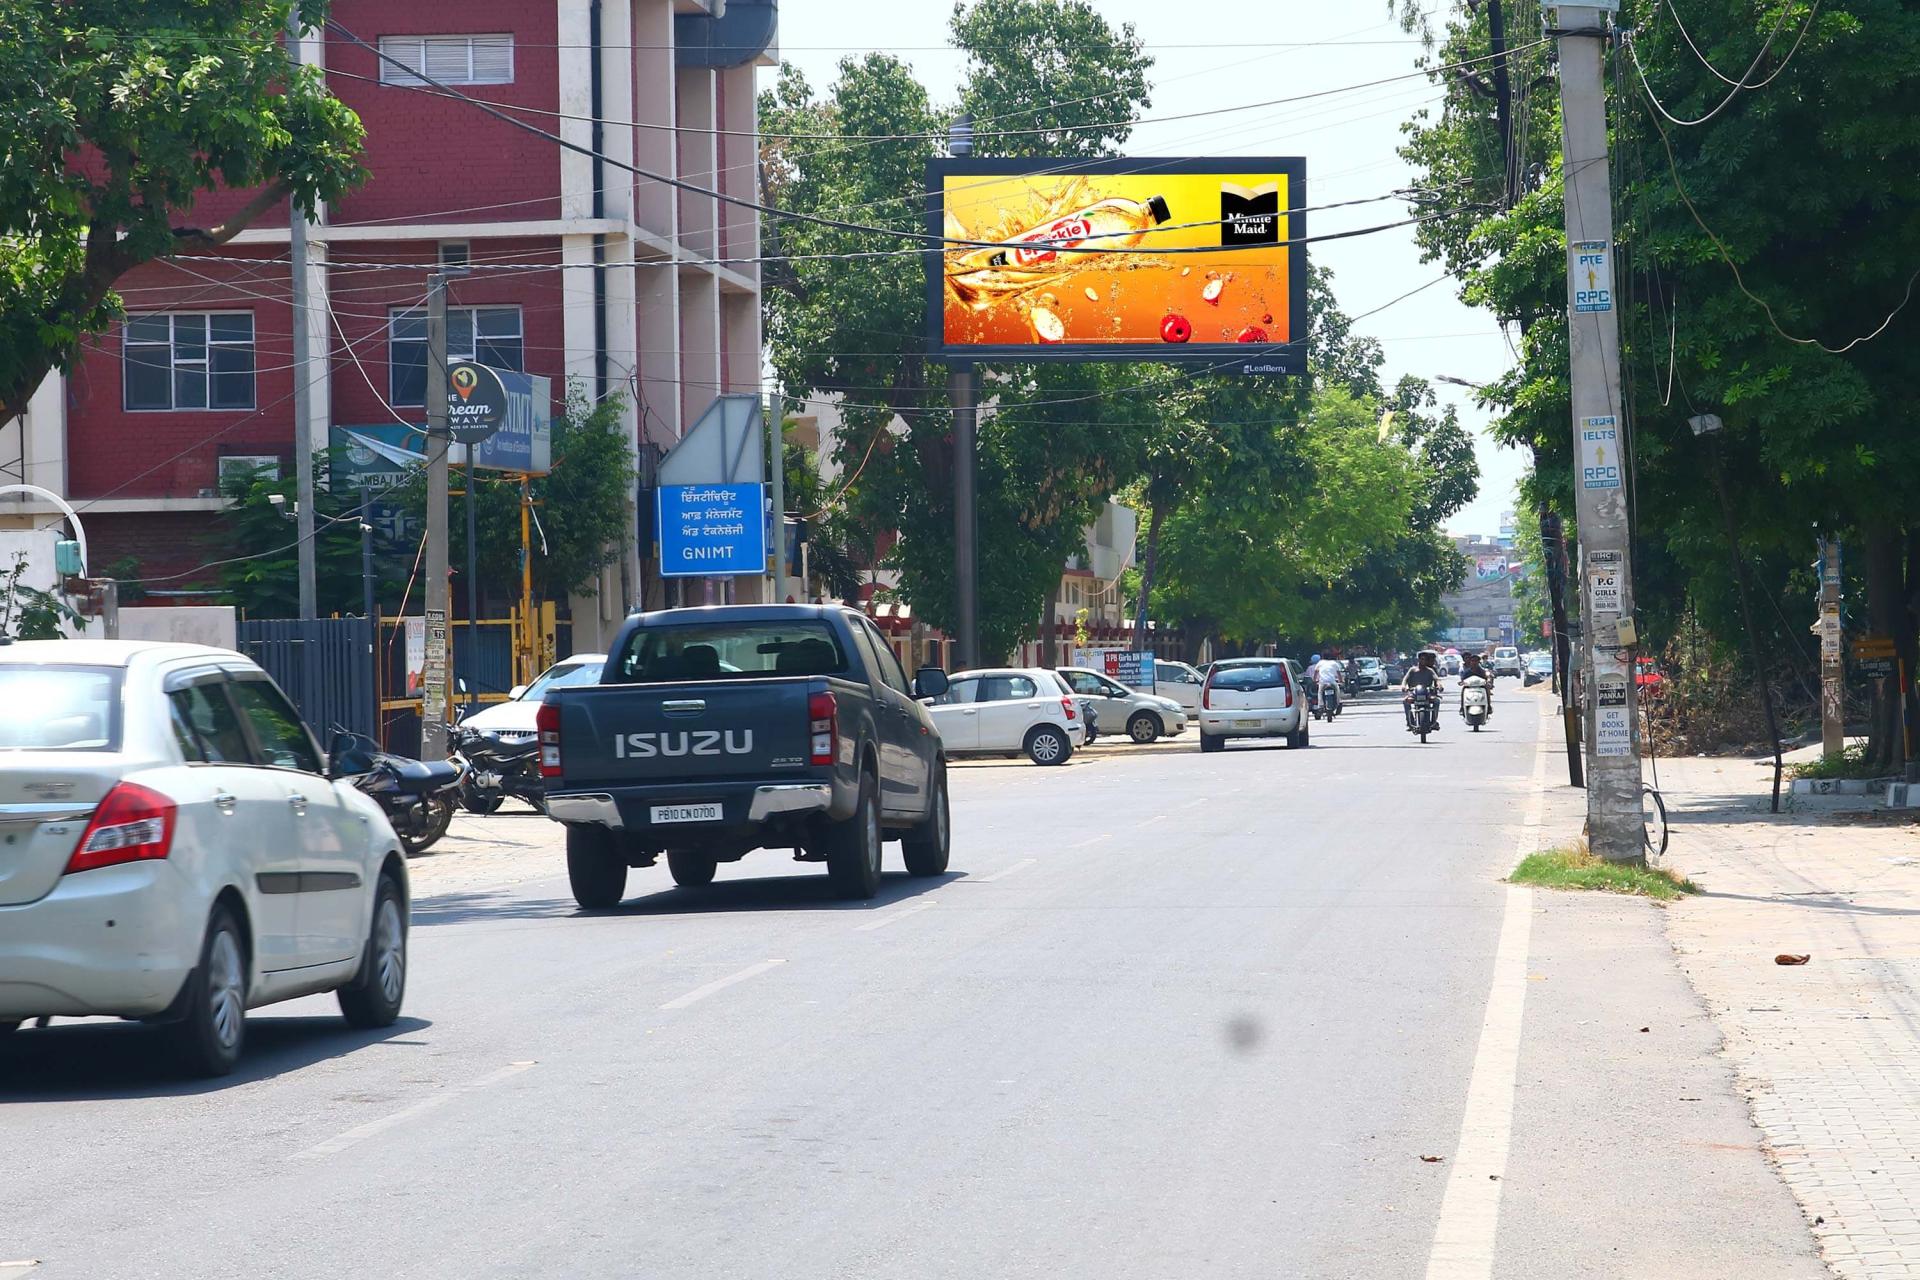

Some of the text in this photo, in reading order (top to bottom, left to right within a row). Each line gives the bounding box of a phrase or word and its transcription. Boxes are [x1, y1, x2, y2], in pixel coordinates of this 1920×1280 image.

[1580, 255, 1603, 265] PTE
[1576, 290, 1609, 303] RPC
[1249, 365, 1286, 374] LeafBerry
[448, 404, 491, 415] ream
[1584, 430, 1616, 440] IELTS
[1584, 467, 1617, 479] RPC
[683, 546, 734, 559] GNIMT
[1597, 577, 1614, 586] P.G
[1118, 653, 1132, 661] Girls
[1606, 711, 1619, 719] GET
[1601, 720, 1625, 728] BOOKS
[1609, 729, 1629, 737] HOME
[615, 729, 753, 759] ISUZU
[658, 805, 716, 821] PB10 CN 0700
